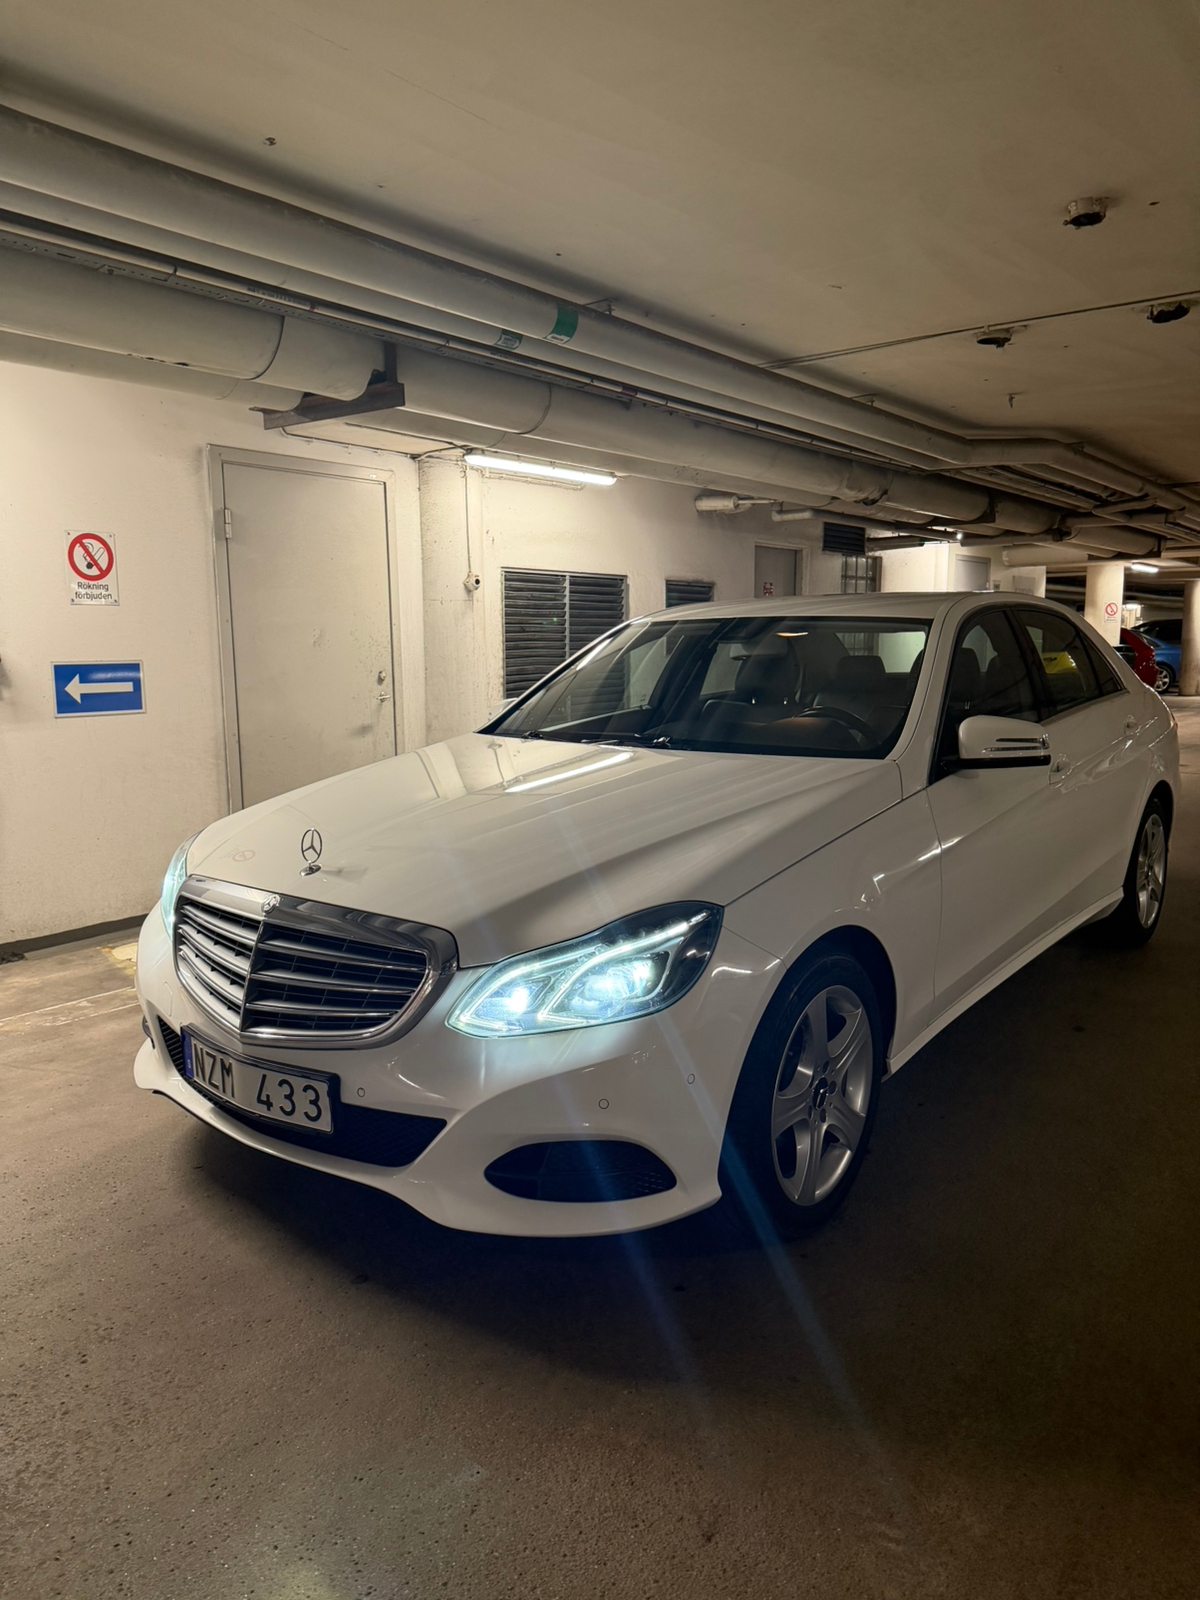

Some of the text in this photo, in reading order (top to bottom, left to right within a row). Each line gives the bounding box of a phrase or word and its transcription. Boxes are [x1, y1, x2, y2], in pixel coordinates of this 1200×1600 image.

[77, 582, 109, 592] Rökning
[75, 591, 112, 600] förbjuden
[193, 1042, 322, 1122] NZM 433
